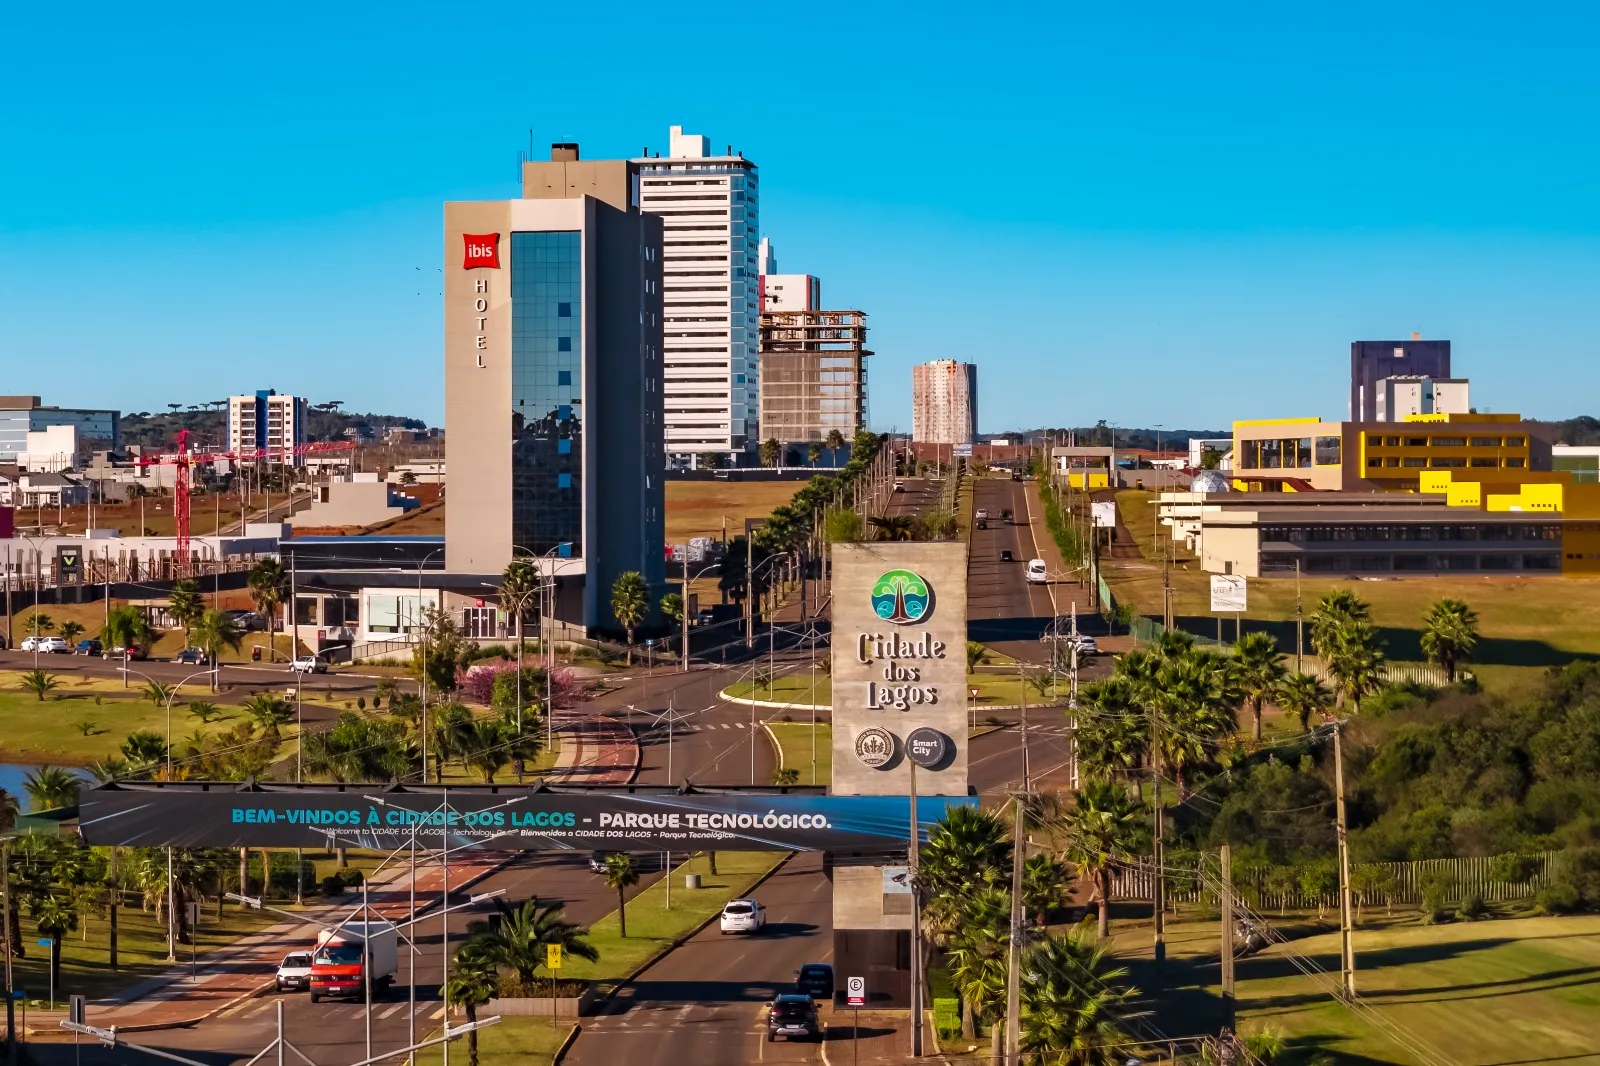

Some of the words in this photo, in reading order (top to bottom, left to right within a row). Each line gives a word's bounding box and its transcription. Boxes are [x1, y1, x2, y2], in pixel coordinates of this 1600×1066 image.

[468, 243, 493, 258] ibis
[475, 279, 488, 369] HOTEL
[857, 631, 946, 664] Cidade
[882, 661, 920, 682] dos
[866, 681, 938, 712] Lagos
[912, 739, 938, 747] Smart
[912, 746, 931, 756] City
[232, 808, 360, 824] BEM-VINDOS
[366, 805, 381, 825] À
[385, 810, 459, 826] CIDADE
[464, 811, 505, 827] DOS
[511, 812, 576, 827] LAGOS
[600, 813, 680, 828] PARQUE
[684, 809, 832, 829] TECNOLÓGICO.
[326, 827, 360, 835] Wlcome
[371, 827, 400, 835] CIDADE
[419, 828, 445, 836] LAGOS
[520, 829, 567, 837] Bienvenidos
[575, 830, 605, 838] CIDADE
[606, 830, 624, 838] DOS
[625, 830, 652, 838] LAGOS
[659, 831, 687, 840] Parque
